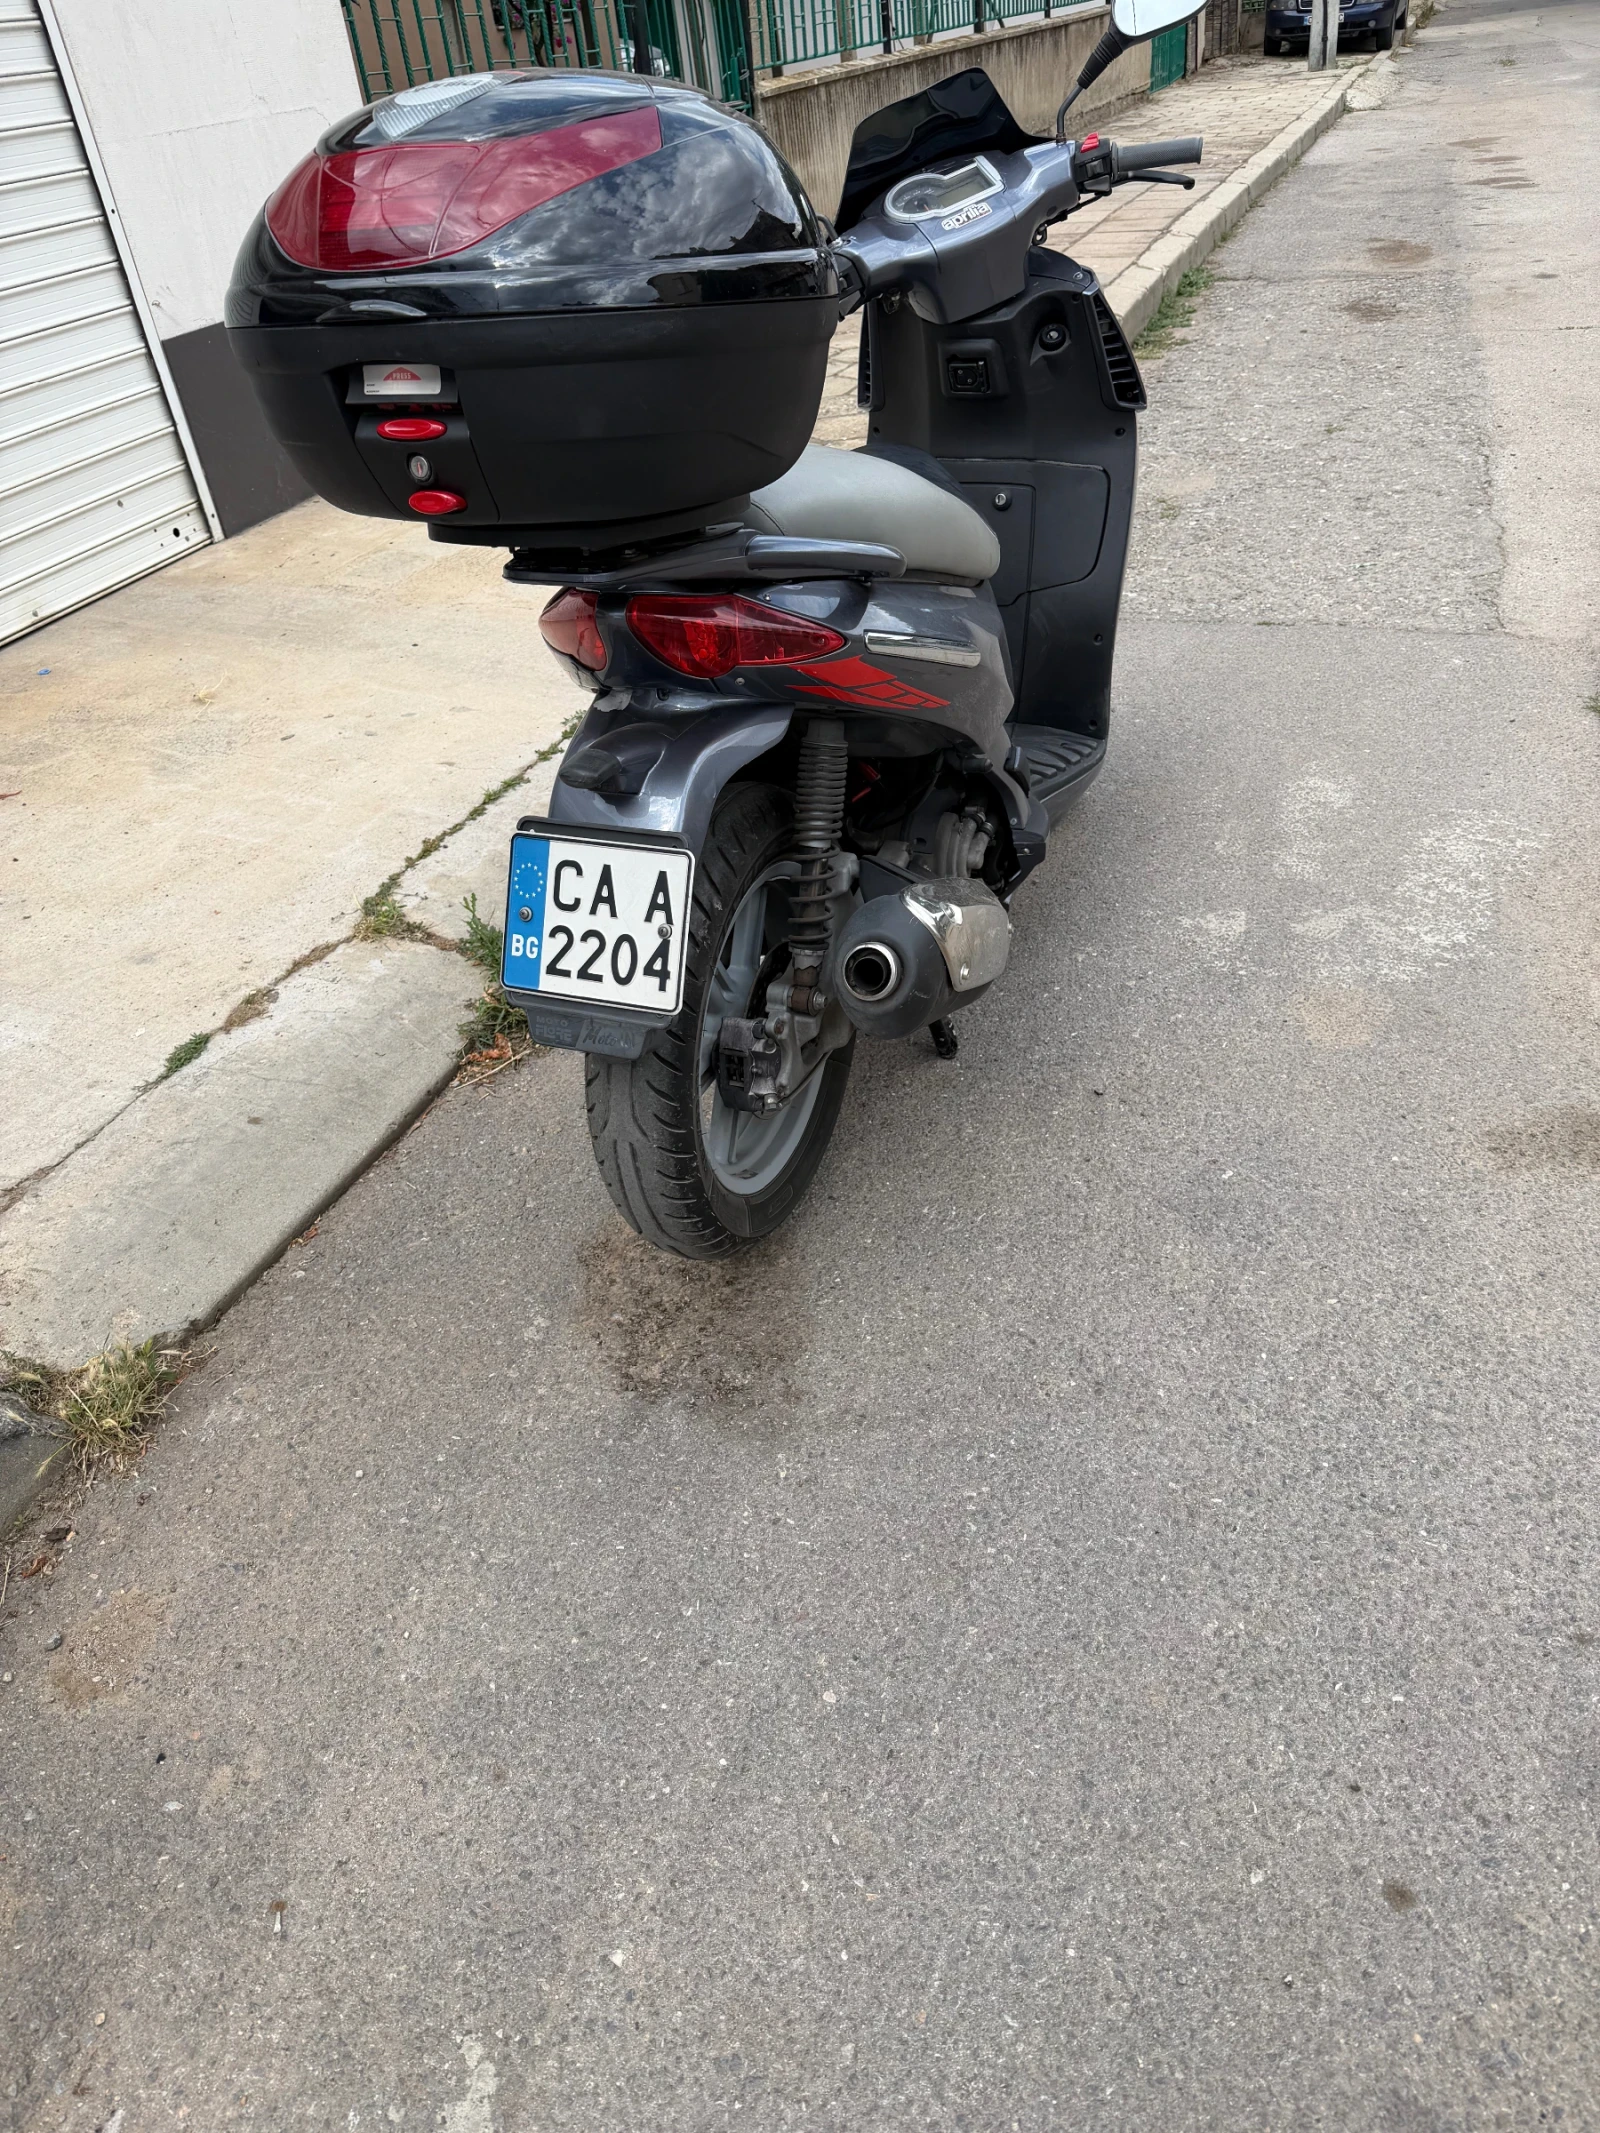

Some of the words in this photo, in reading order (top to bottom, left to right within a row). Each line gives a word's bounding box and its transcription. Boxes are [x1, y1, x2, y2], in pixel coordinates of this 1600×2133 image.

[943, 203, 991, 229] aprilia
[553, 859, 618, 918] CA
[644, 870, 674, 926] A
[511, 934, 539, 958] BG
[545, 924, 671, 992] 2204
